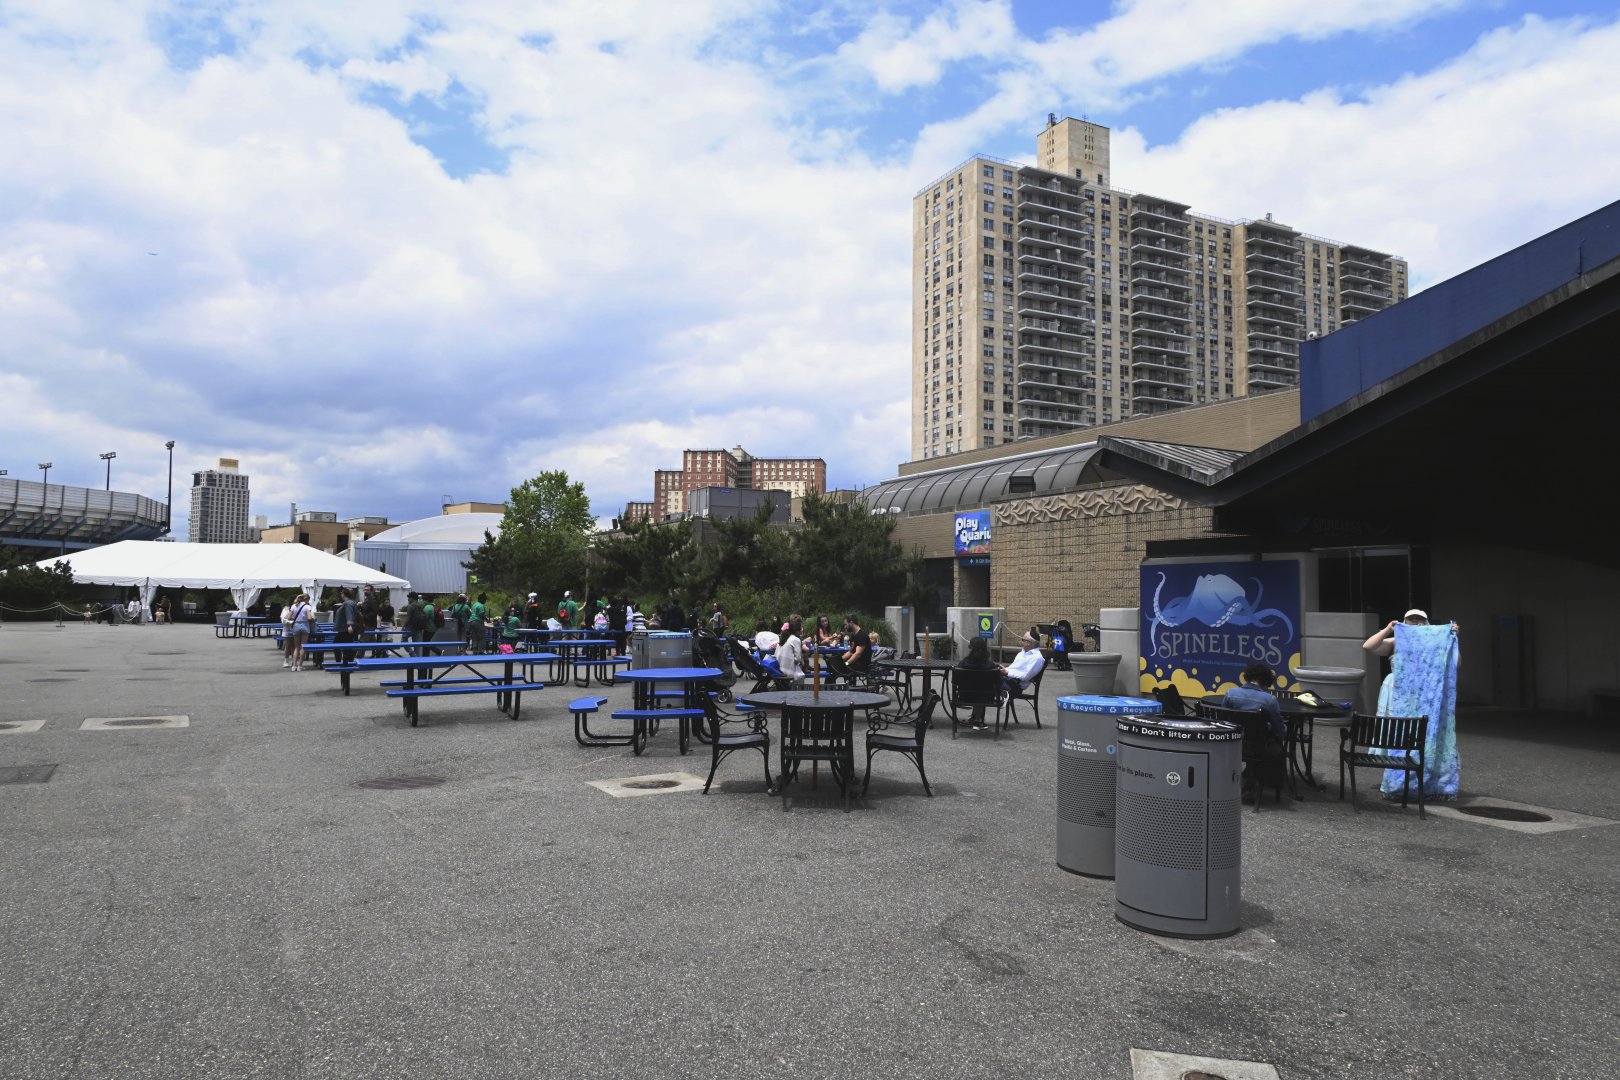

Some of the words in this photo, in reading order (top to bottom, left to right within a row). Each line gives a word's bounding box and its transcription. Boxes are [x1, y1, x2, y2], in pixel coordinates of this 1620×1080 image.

[956, 517, 978, 536] Play
[1158, 631, 1283, 666] SPINELESS
[1070, 703, 1102, 712] Recycle
[1141, 727, 1165, 737] Don't
[1168, 731, 1191, 739] litter
[1208, 732, 1230, 740] Don't
[1134, 769, 1156, 779] place.
